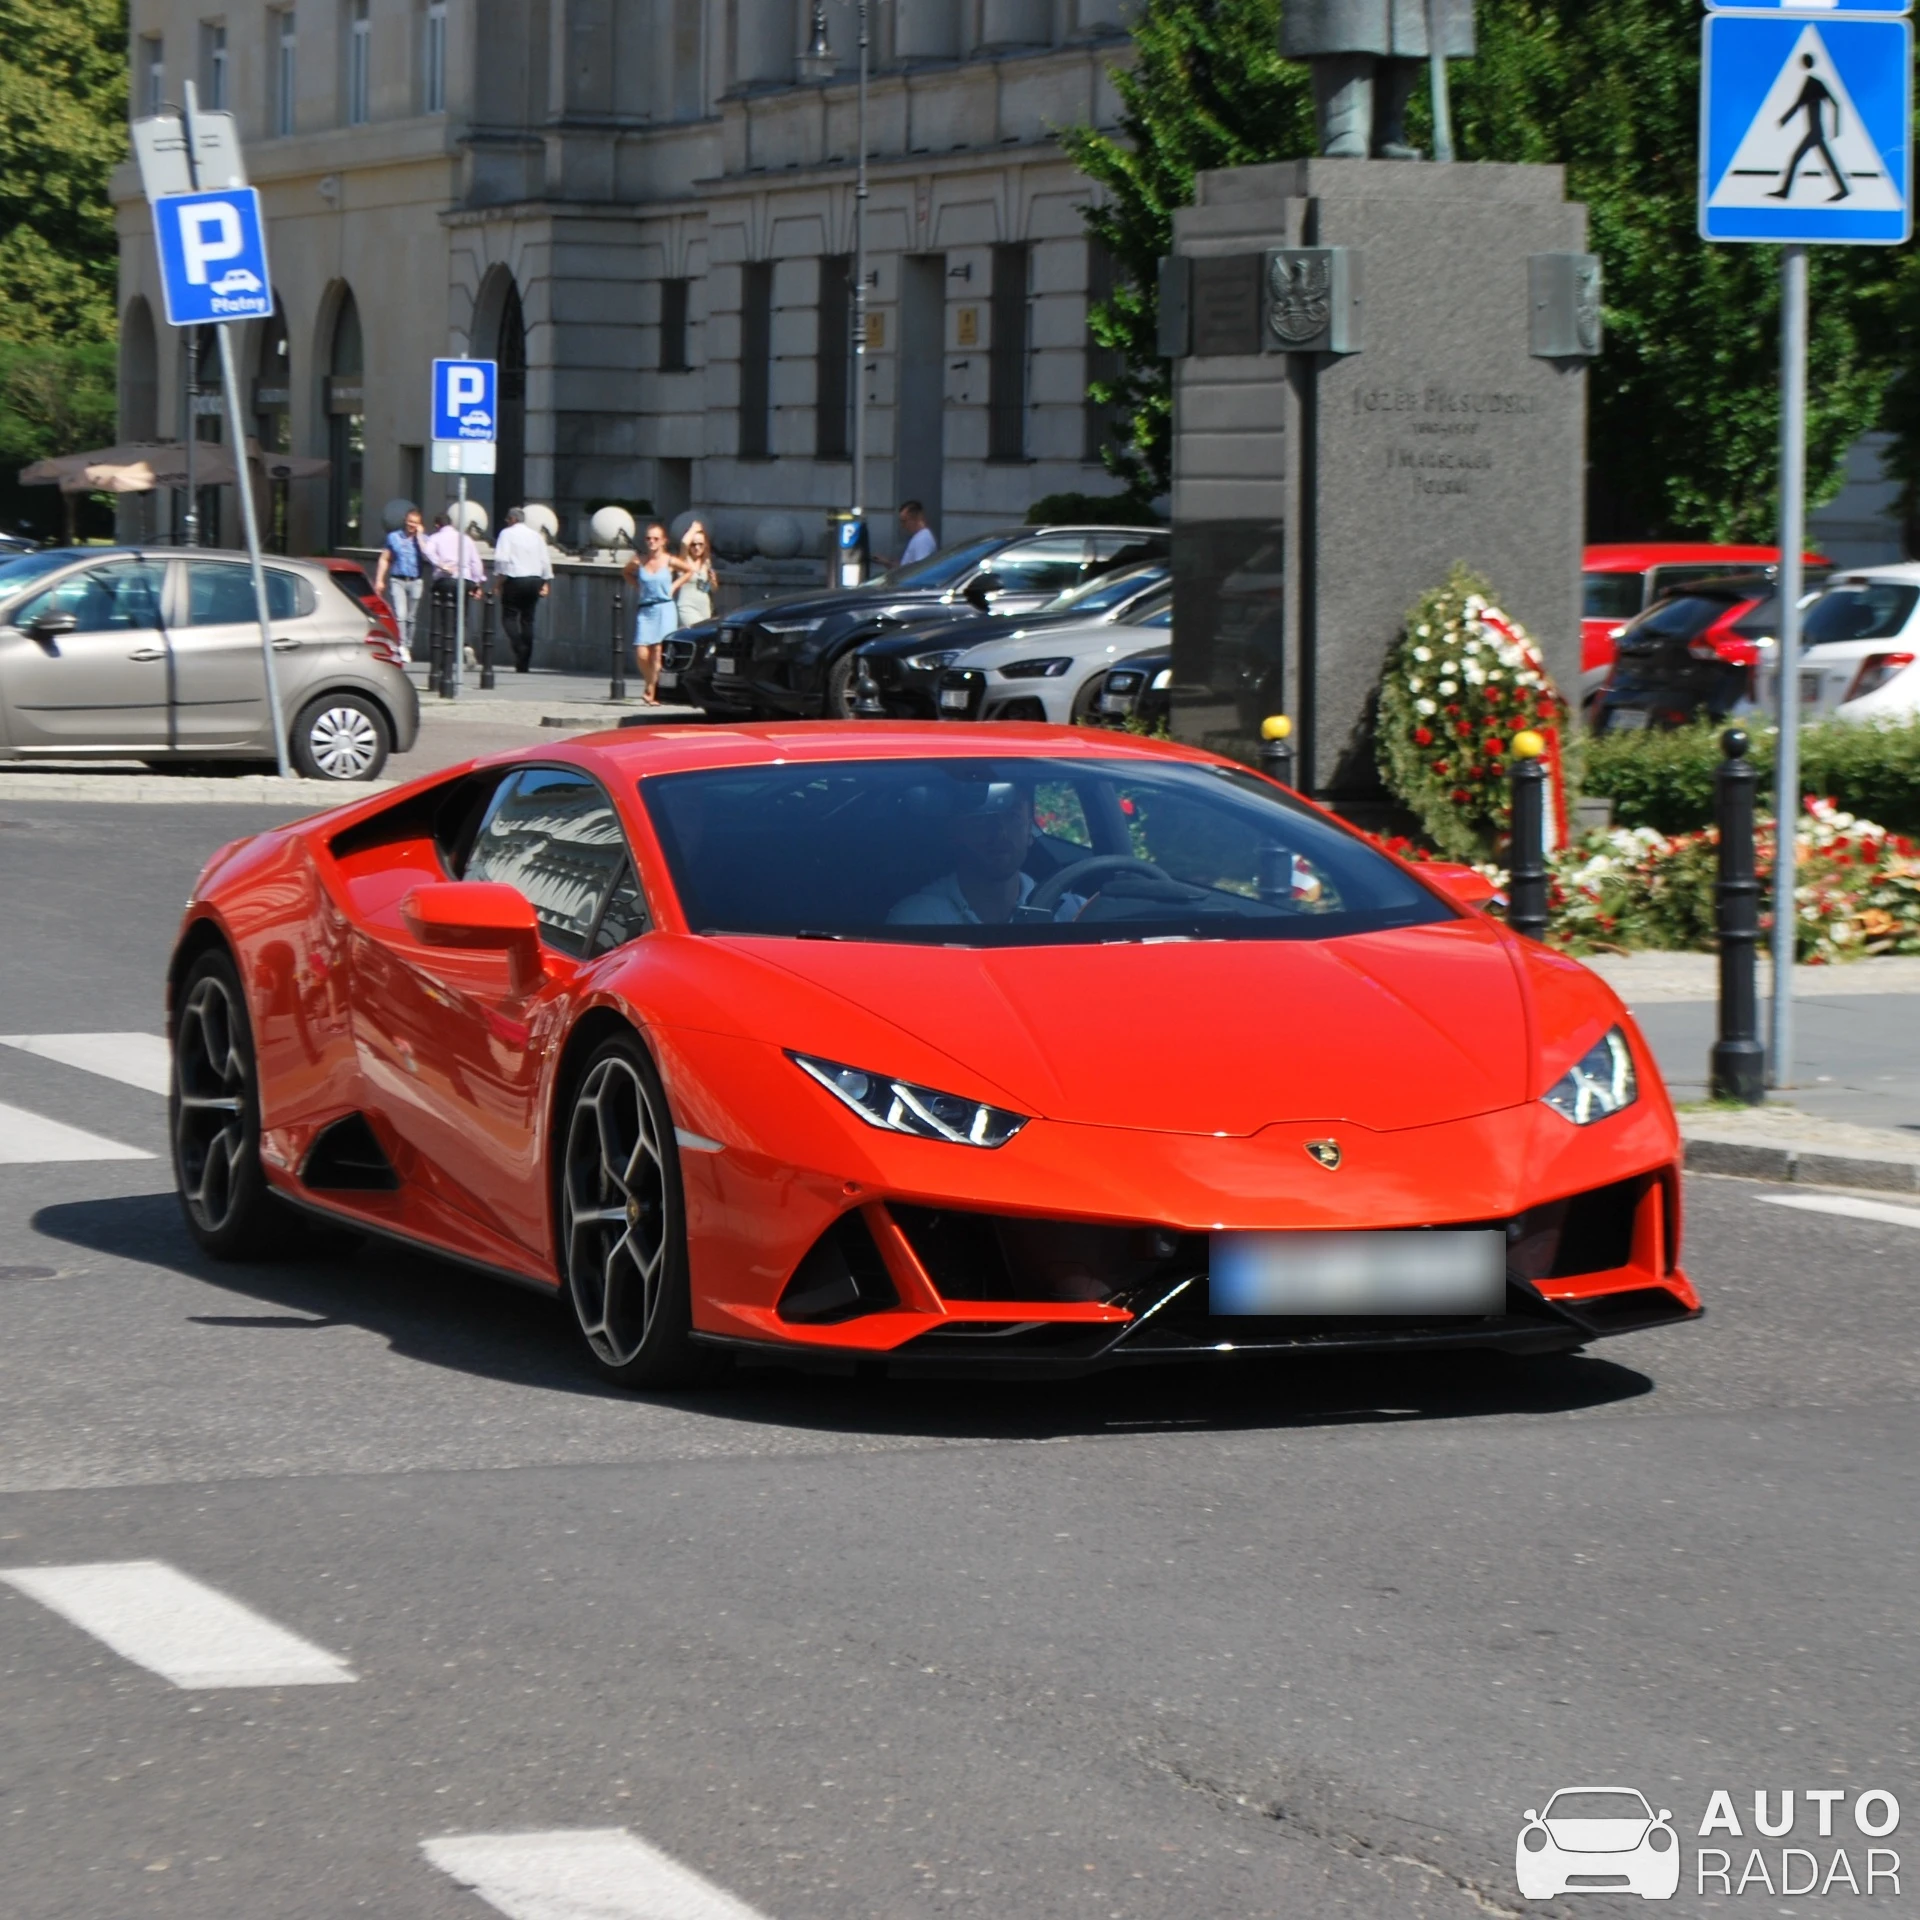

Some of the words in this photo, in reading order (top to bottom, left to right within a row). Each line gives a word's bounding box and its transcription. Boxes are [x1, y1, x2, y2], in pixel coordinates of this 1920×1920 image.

[177, 201, 243, 285] P
[446, 366, 485, 418] P
[843, 523, 856, 545] P
